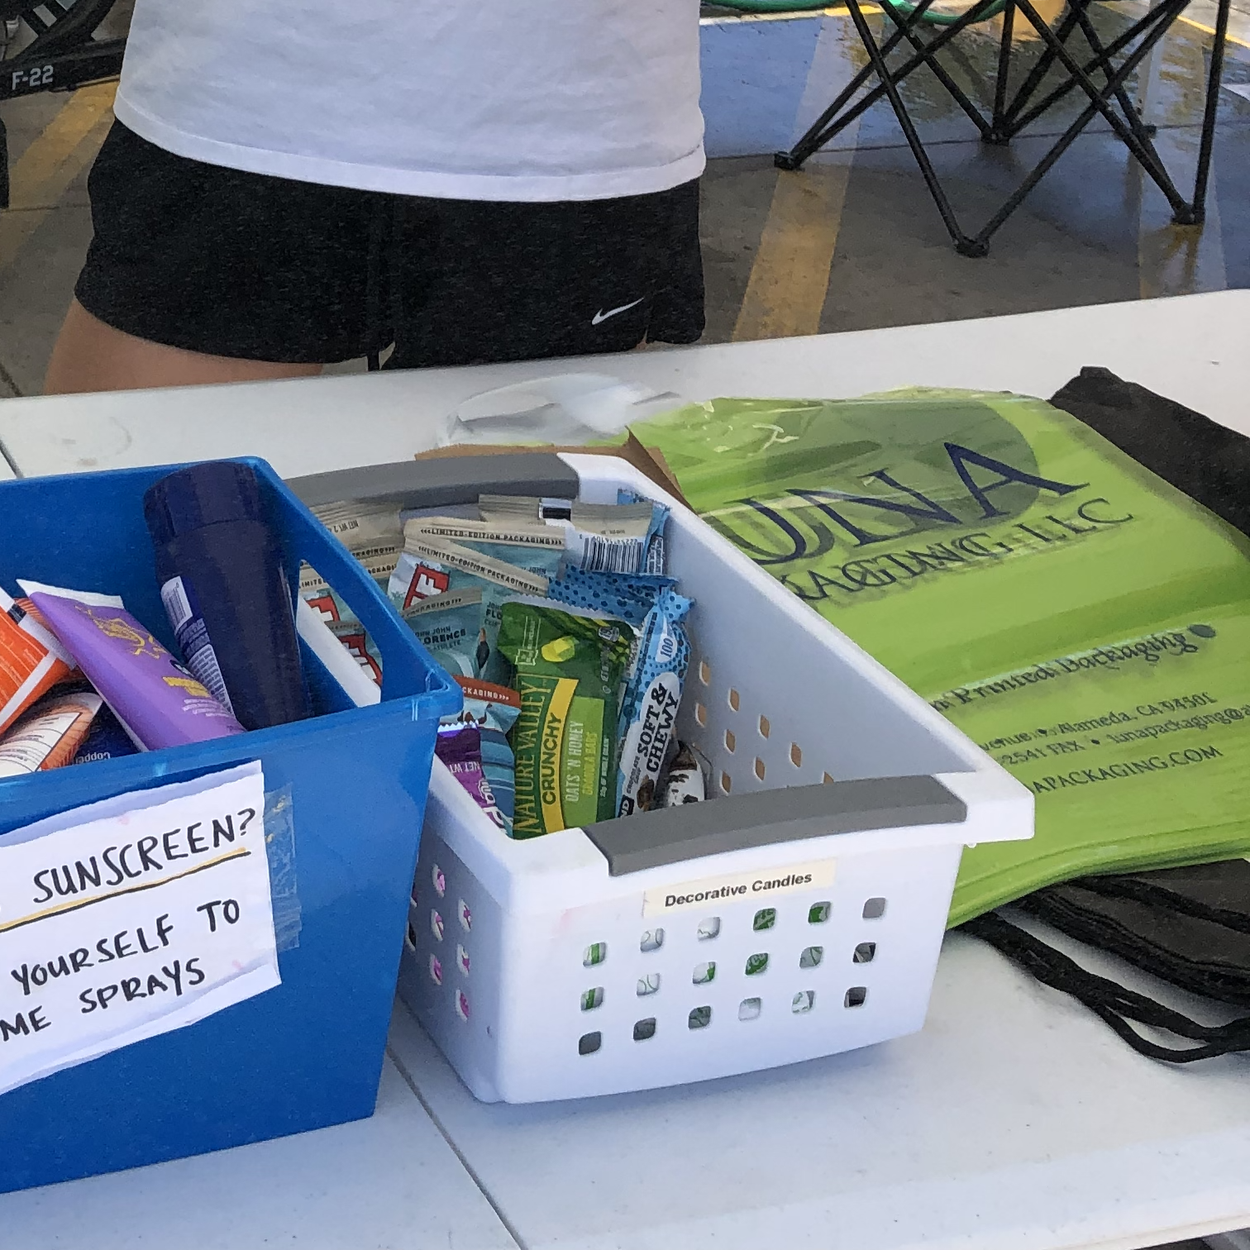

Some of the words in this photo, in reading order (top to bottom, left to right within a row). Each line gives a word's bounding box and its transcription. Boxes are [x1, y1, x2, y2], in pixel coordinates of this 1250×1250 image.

[12, 64, 54, 91] F-22
[725, 440, 1090, 567] UNA
[423, 628, 466, 645] ORENCE
[659, 636, 675, 659] 100
[951, 664, 1055, 705] Printed
[519, 680, 552, 746] VALLEY
[567, 720, 584, 758] HONEY
[637, 705, 661, 758] SOFT
[651, 682, 668, 704] &
[646, 692, 680, 773] CHEWY
[1047, 739, 1085, 757] FAX
[1107, 703, 1250, 744] lunapackaging@a
[464, 761, 480, 772] NET
[541, 712, 562, 806] CRUNCHY
[981, 730, 1032, 751] venue
[513, 742, 544, 834] NATURE
[565, 775, 580, 802] OATS
[1024, 744, 1224, 795] APACKAGING.COM
[32, 807, 257, 904] SUNSCREEN?
[664, 884, 748, 907] Decorative
[751, 872, 813, 893] Candles
[10, 913, 175, 997] YOURSELF
[196, 899, 240, 932] TO
[78, 958, 206, 1014] SPRAYS
